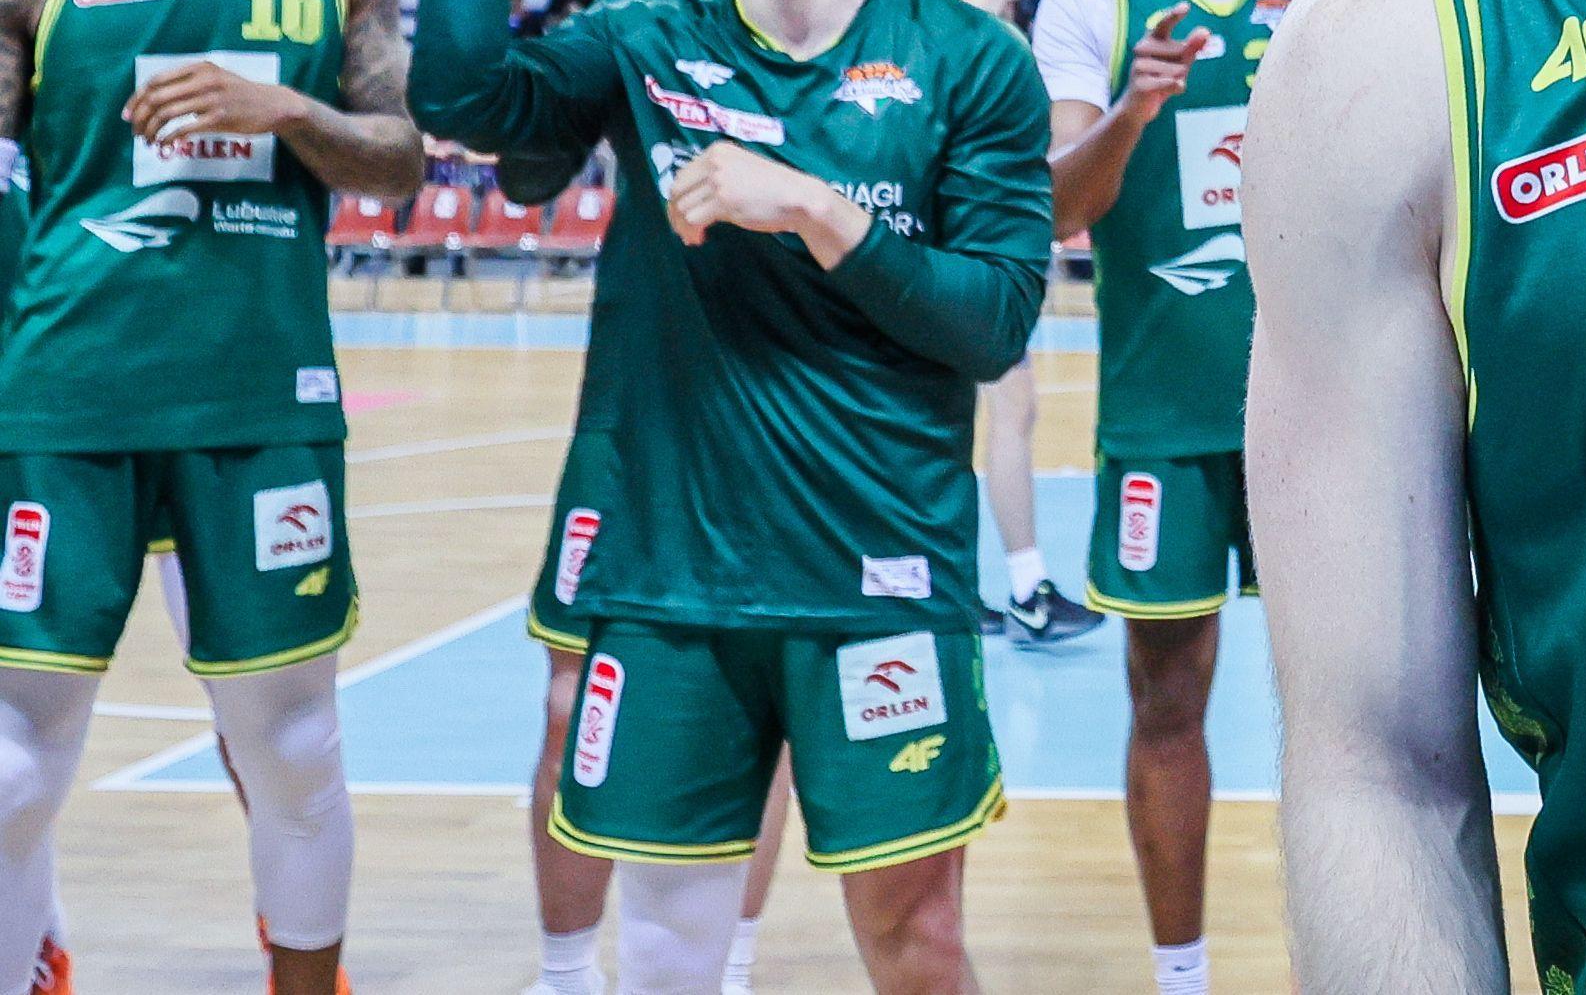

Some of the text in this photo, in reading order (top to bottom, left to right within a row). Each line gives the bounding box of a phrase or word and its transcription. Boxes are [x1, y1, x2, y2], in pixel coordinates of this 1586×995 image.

[156, 140, 253, 161] ORLEN
[862, 697, 929, 723] ORLEN
[889, 734, 946, 773] 4F
